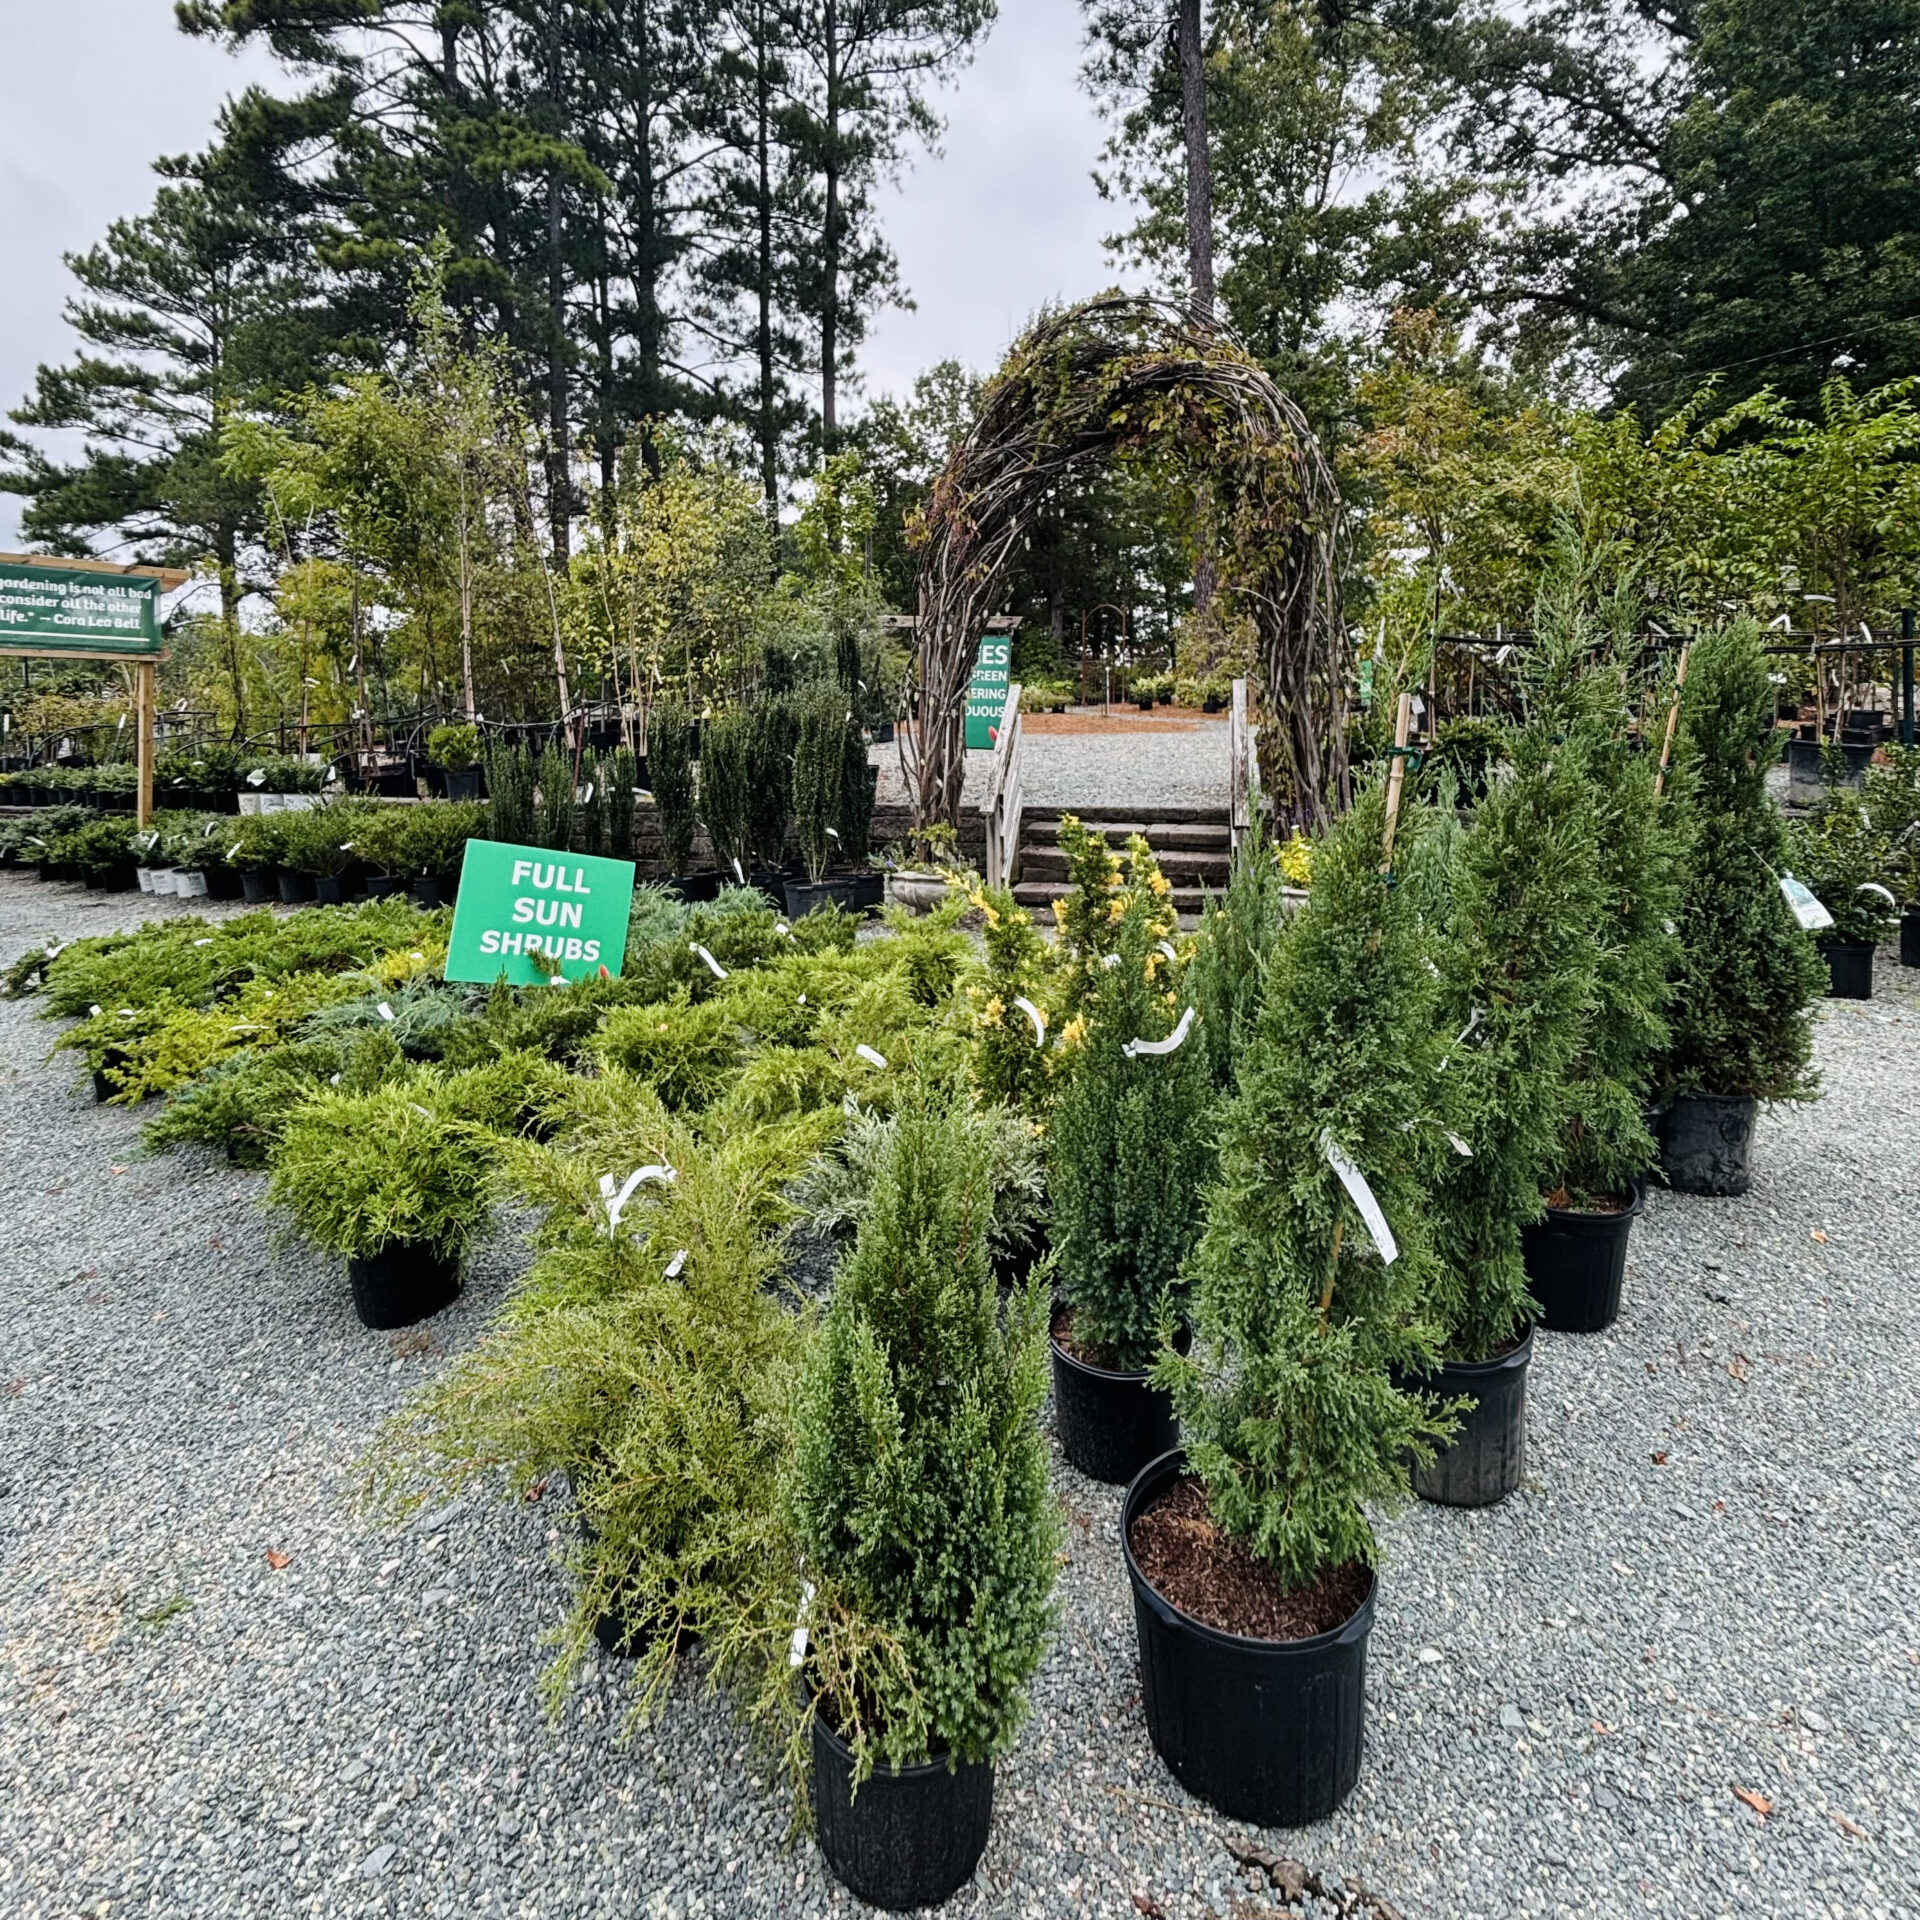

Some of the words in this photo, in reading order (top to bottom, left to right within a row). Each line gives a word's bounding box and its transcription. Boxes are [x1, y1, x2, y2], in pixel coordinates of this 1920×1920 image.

[69, 582, 80, 594] is
[83, 584, 106, 596] not
[108, 587, 127, 598] all
[128, 588, 152, 600] bad
[0, 594, 59, 608] consider
[61, 598, 82, 610] all
[83, 599, 105, 611] the
[107, 602, 142, 614] other
[54, 614, 86, 627] Cora
[114, 617, 141, 629] Bell
[979, 645, 1008, 665] ES
[511, 860, 591, 894] FULL
[512, 897, 583, 929] SUN
[479, 930, 601, 962] SHRUBS
